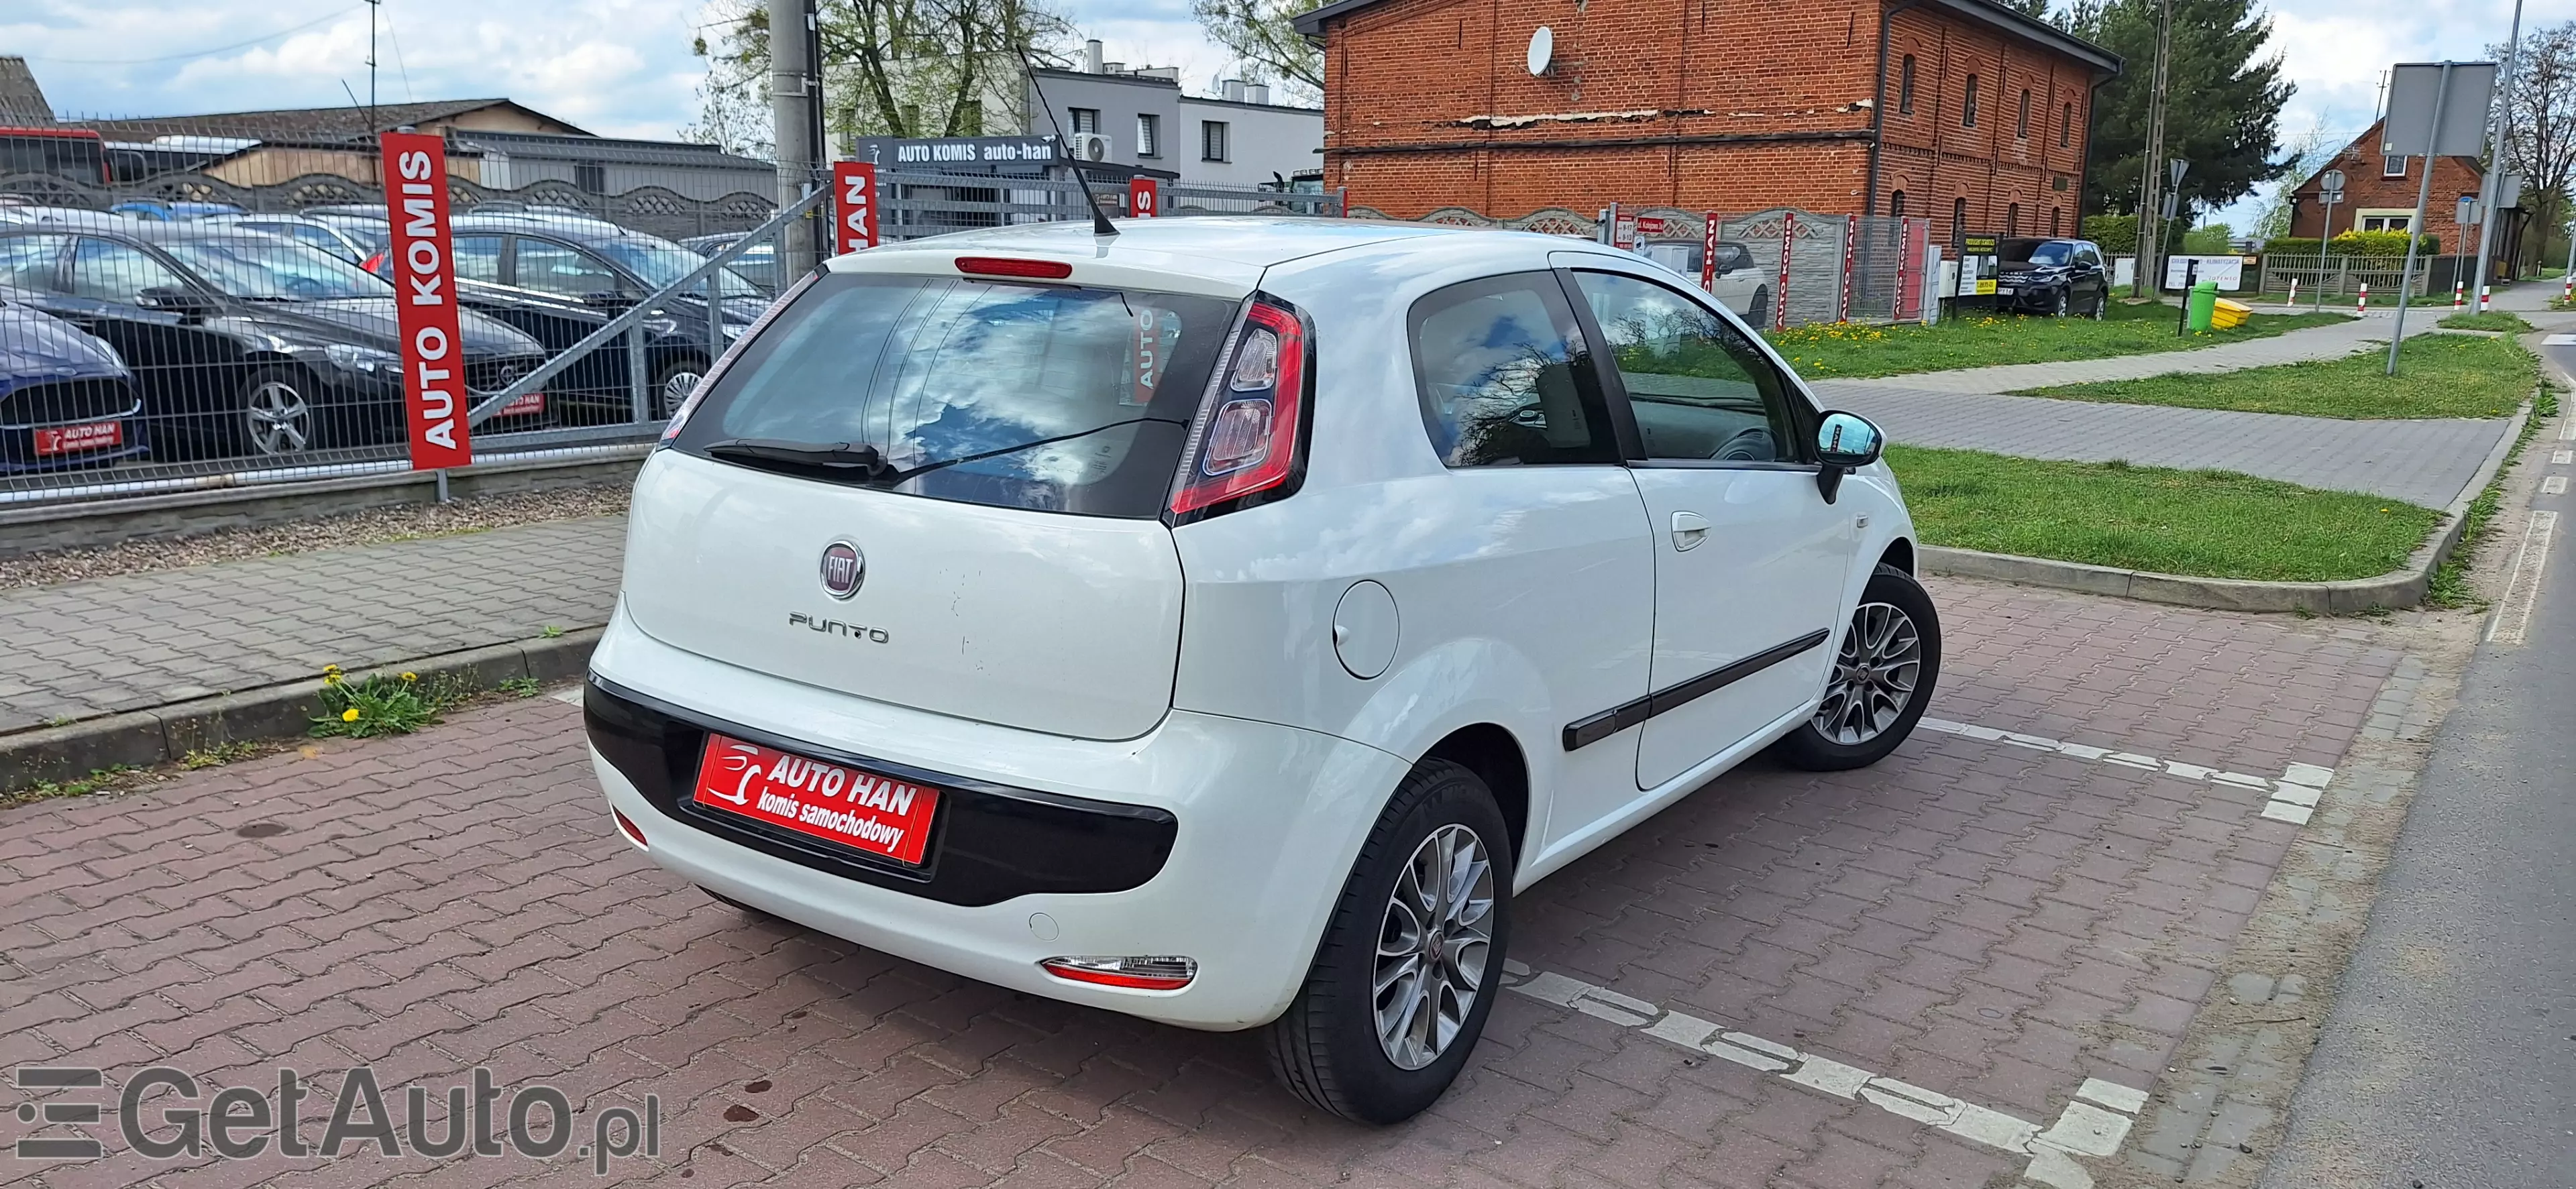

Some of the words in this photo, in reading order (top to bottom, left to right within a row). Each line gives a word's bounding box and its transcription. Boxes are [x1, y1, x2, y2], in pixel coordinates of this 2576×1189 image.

[898, 145, 930, 162] AUTO
[933, 144, 976, 162] KOMIS
[983, 142, 1052, 161] auto-han
[398, 150, 443, 306] KOMIS
[1899, 223, 1908, 270] KOMIS
[1778, 281, 1786, 327] AUTO
[1782, 219, 1792, 275] KOMIS
[1140, 309, 1155, 390] AUTO
[415, 326, 457, 450] AUTO
[64, 427, 93, 439] AUTO
[827, 555, 854, 584] FIAT
[788, 610, 890, 644] PUNTO
[766, 755, 846, 797] AUTO
[847, 774, 918, 817] HAN
[756, 785, 800, 819] komis
[798, 803, 905, 853] samochodowy
